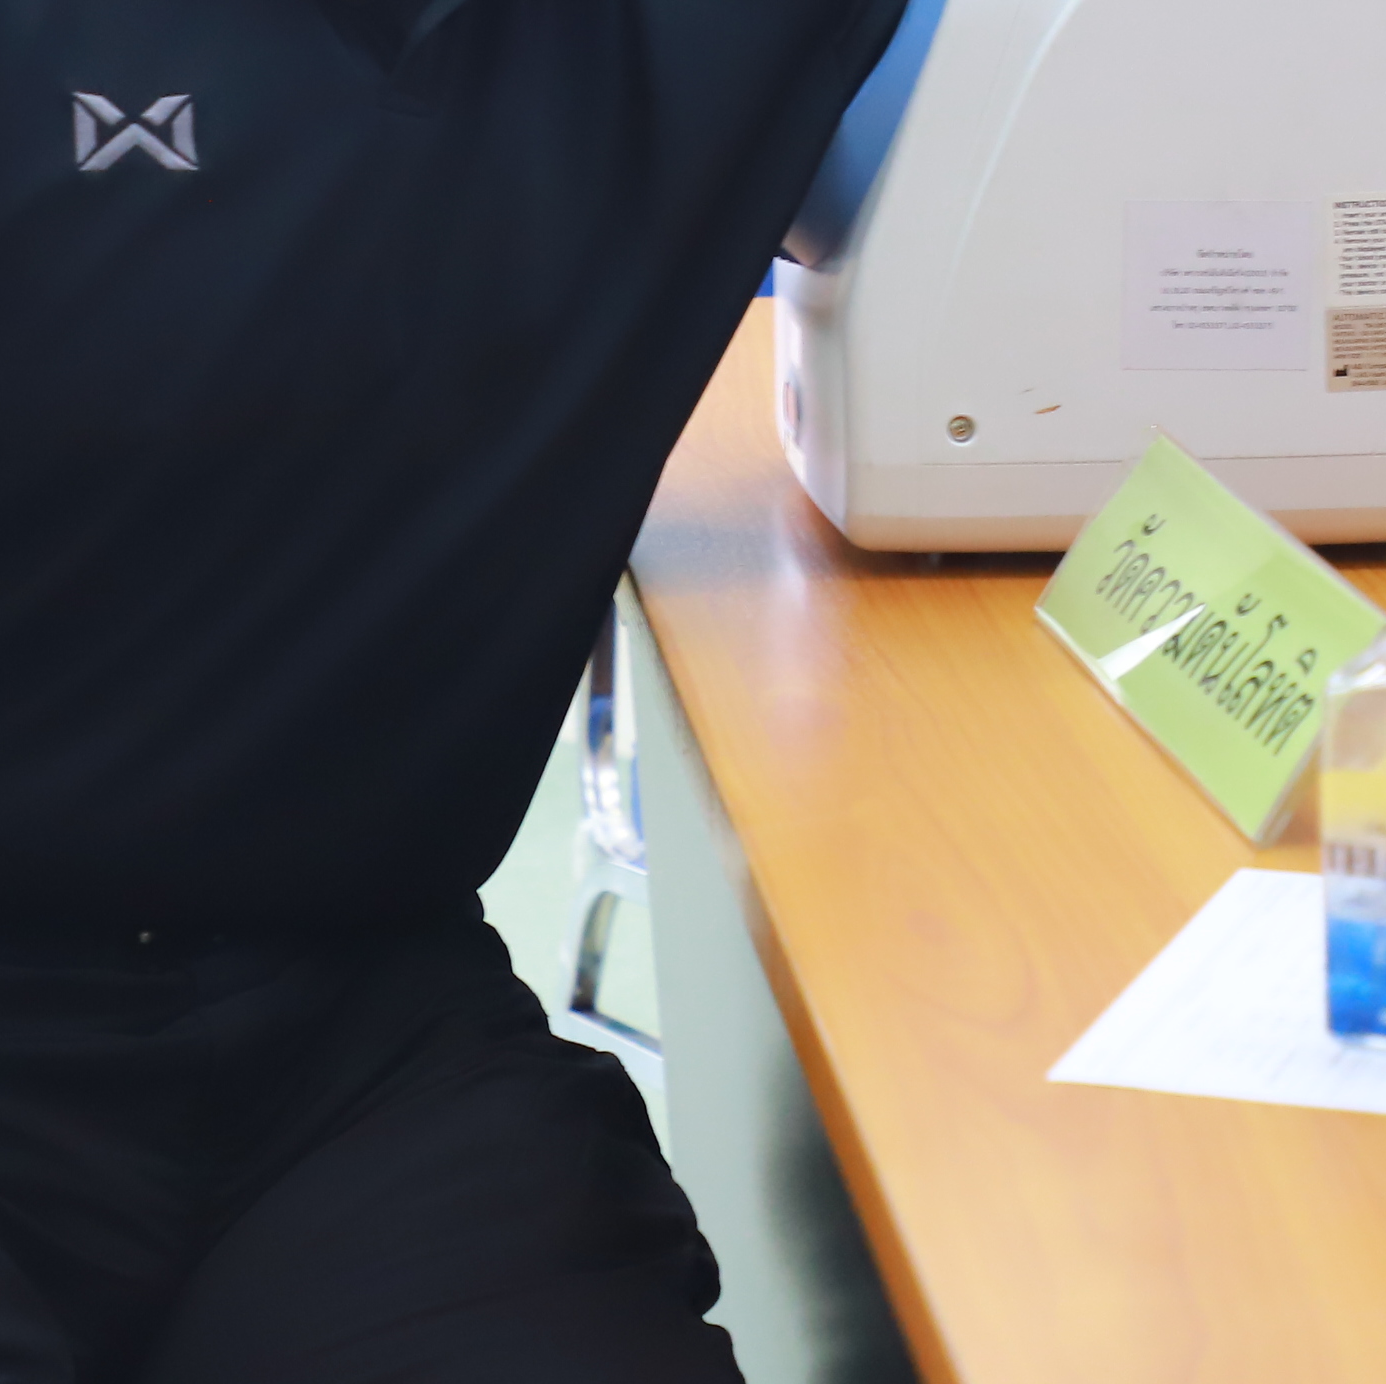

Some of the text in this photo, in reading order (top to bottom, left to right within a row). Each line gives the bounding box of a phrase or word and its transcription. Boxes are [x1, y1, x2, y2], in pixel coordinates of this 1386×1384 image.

[1095, 512, 1319, 756] วัดความดันโลหิต
